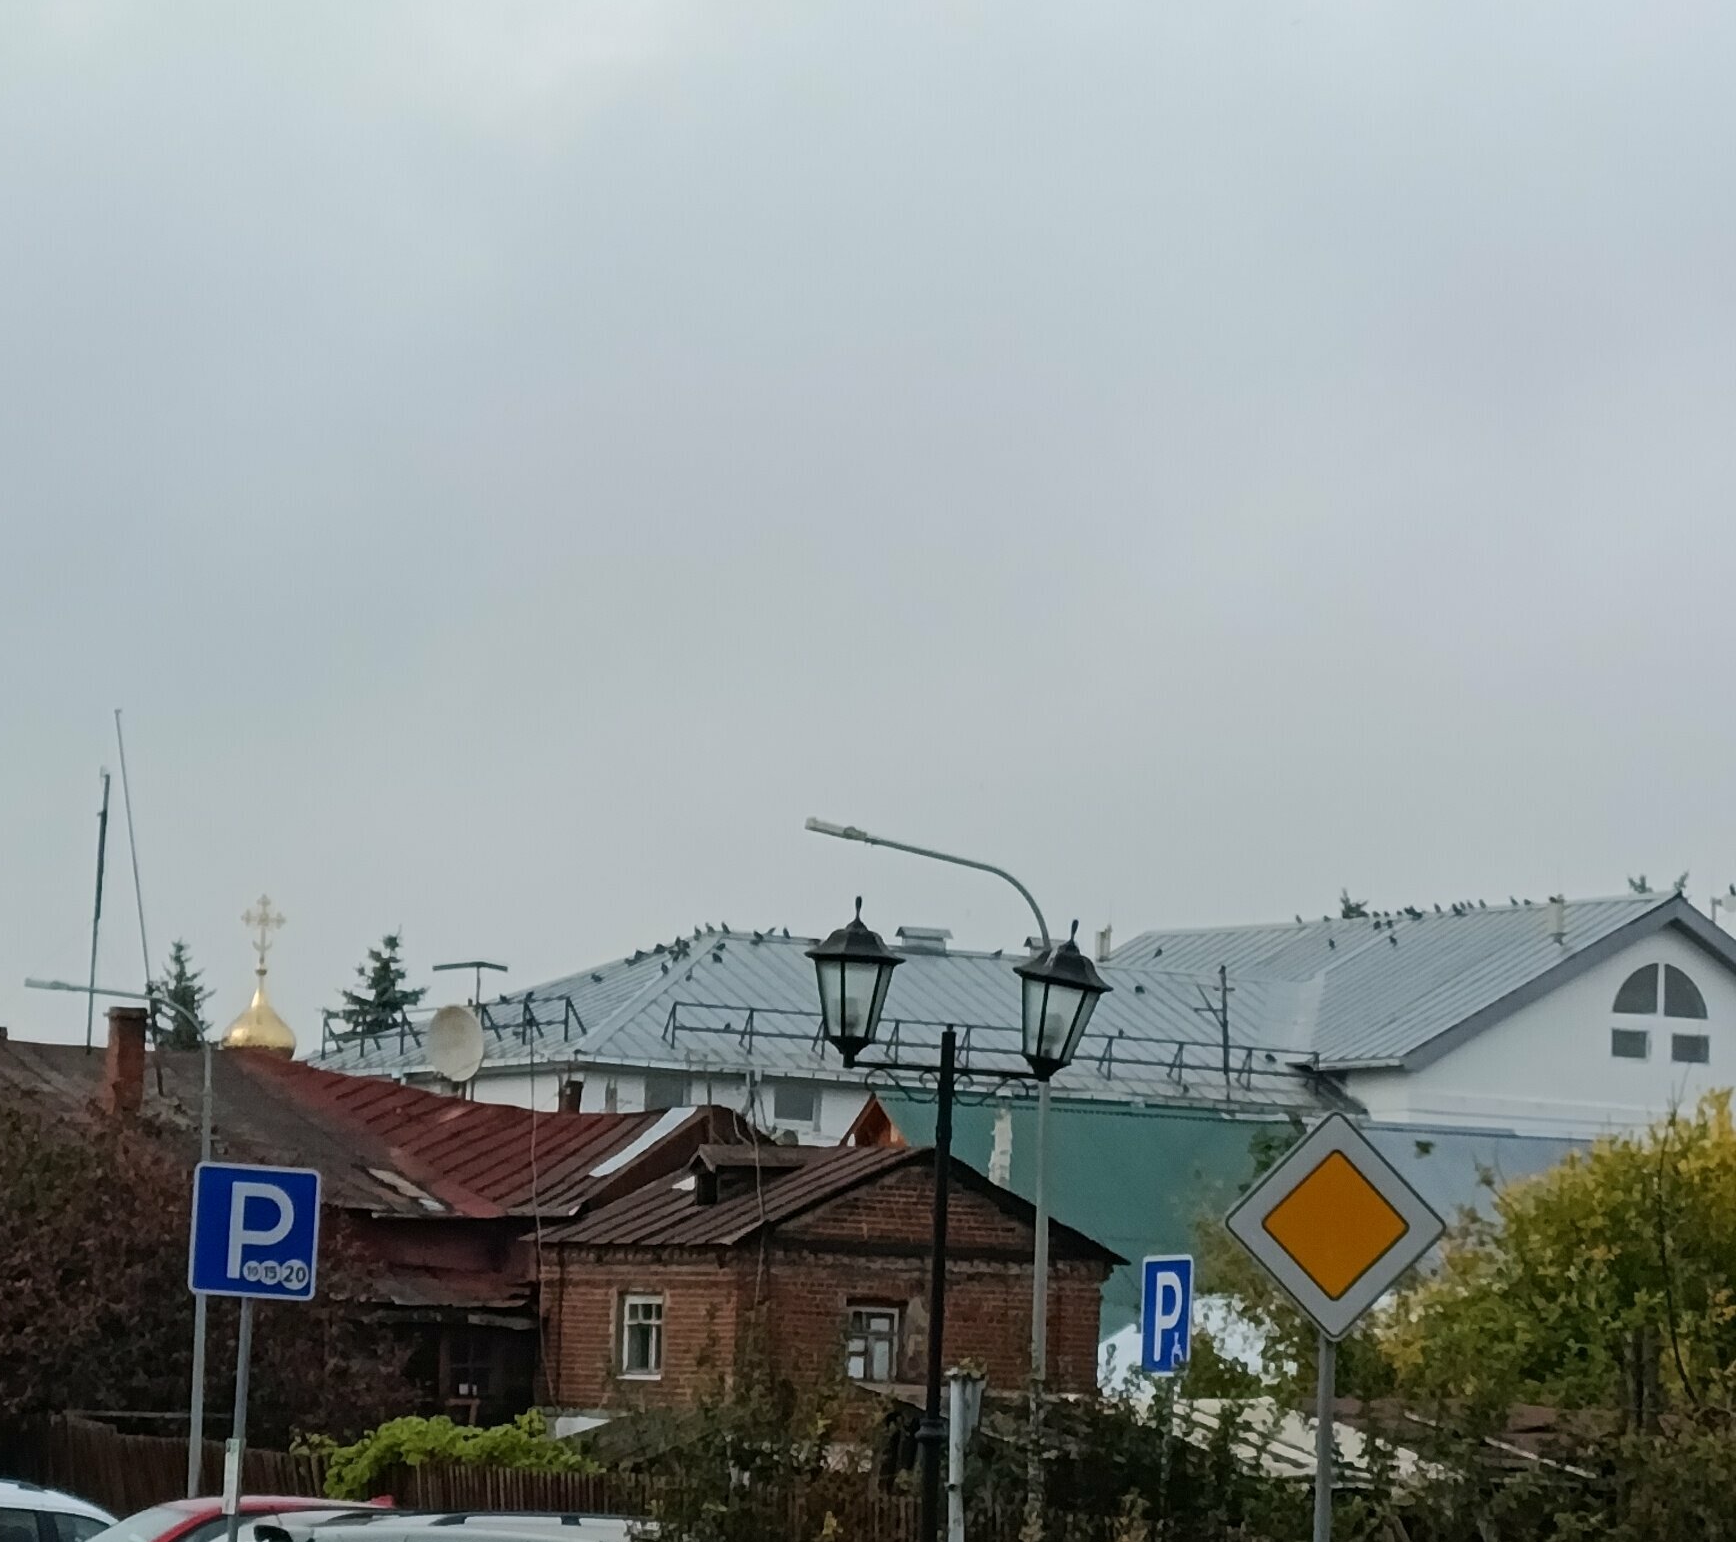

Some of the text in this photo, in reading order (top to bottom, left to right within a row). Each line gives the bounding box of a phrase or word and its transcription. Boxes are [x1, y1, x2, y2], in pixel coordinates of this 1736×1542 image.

[226, 1181, 295, 1279] P
[264, 1265, 278, 1280] 15
[283, 1265, 307, 1283] 20
[1153, 1271, 1183, 1362] P
